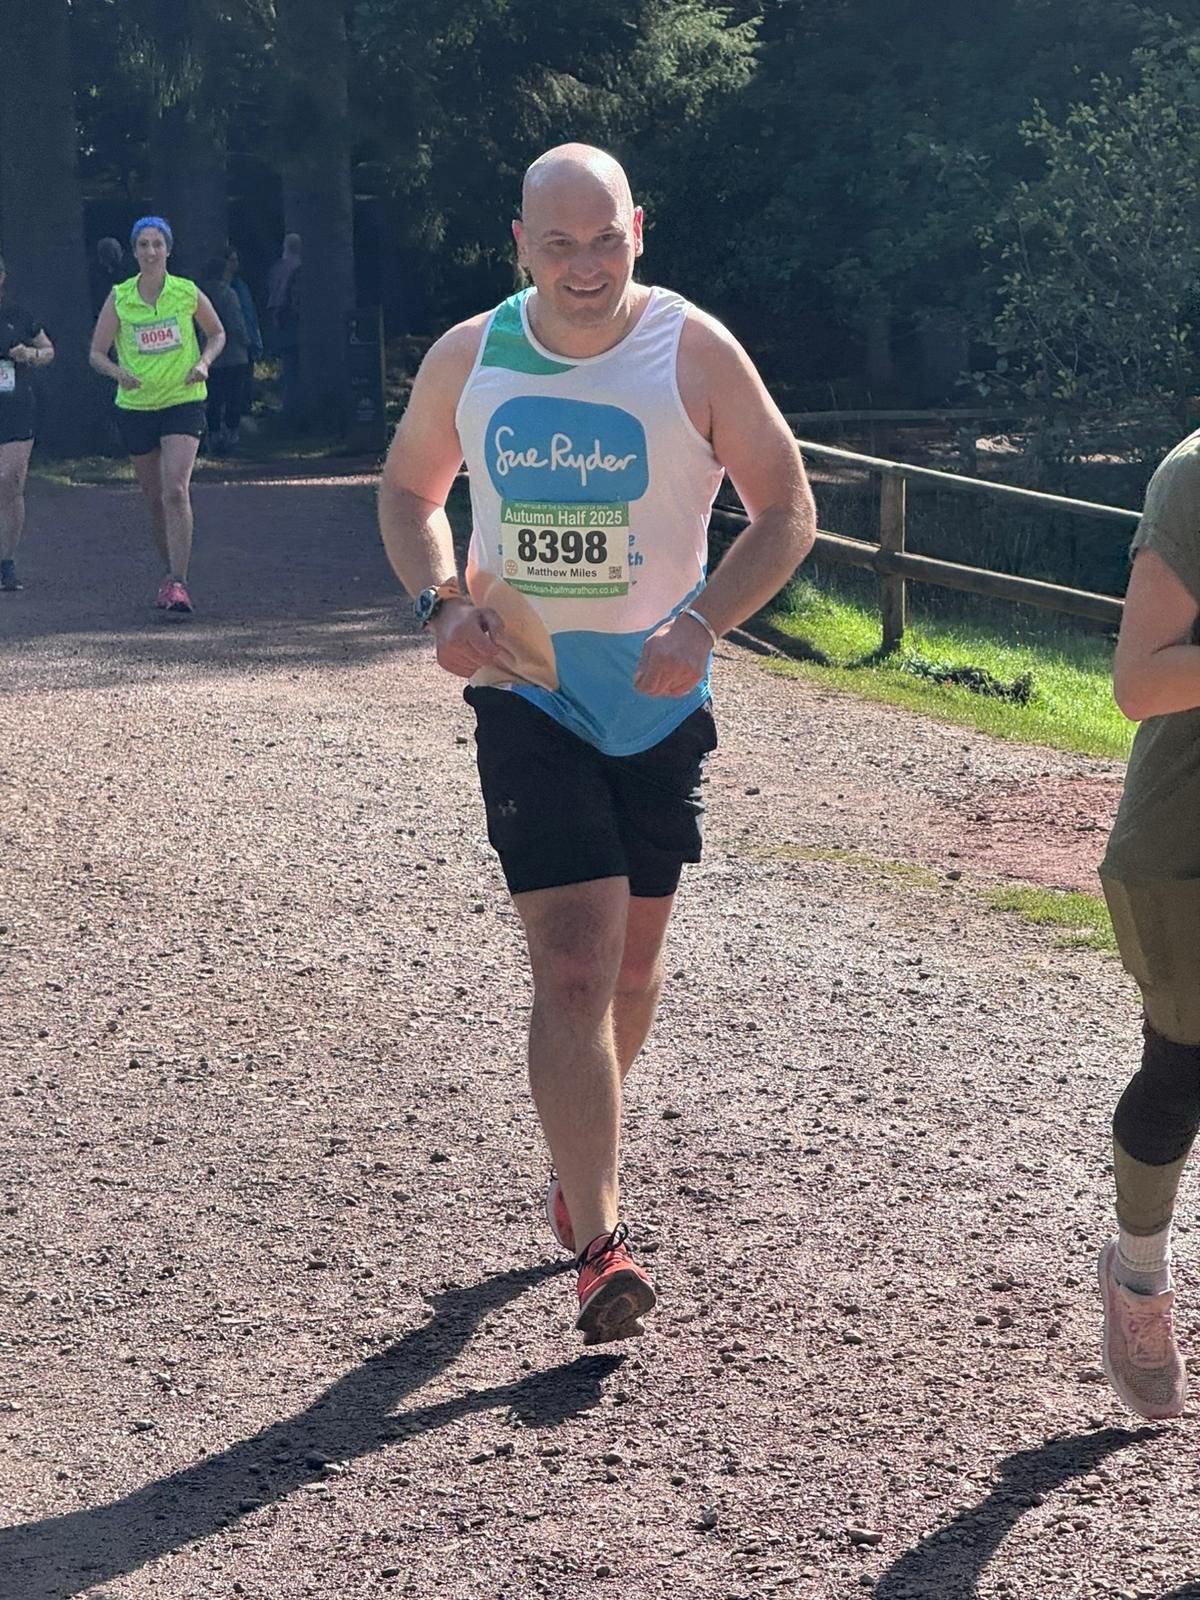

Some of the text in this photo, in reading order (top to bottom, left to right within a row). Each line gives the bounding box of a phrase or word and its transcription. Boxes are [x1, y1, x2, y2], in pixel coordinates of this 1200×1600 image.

[141, 328, 174, 345] 8094
[495, 425, 637, 487] Sue Ryder
[504, 508, 623, 525] Autumn Half 2025
[517, 528, 608, 565] 8398
[527, 566, 598, 578] Matthew Miles
